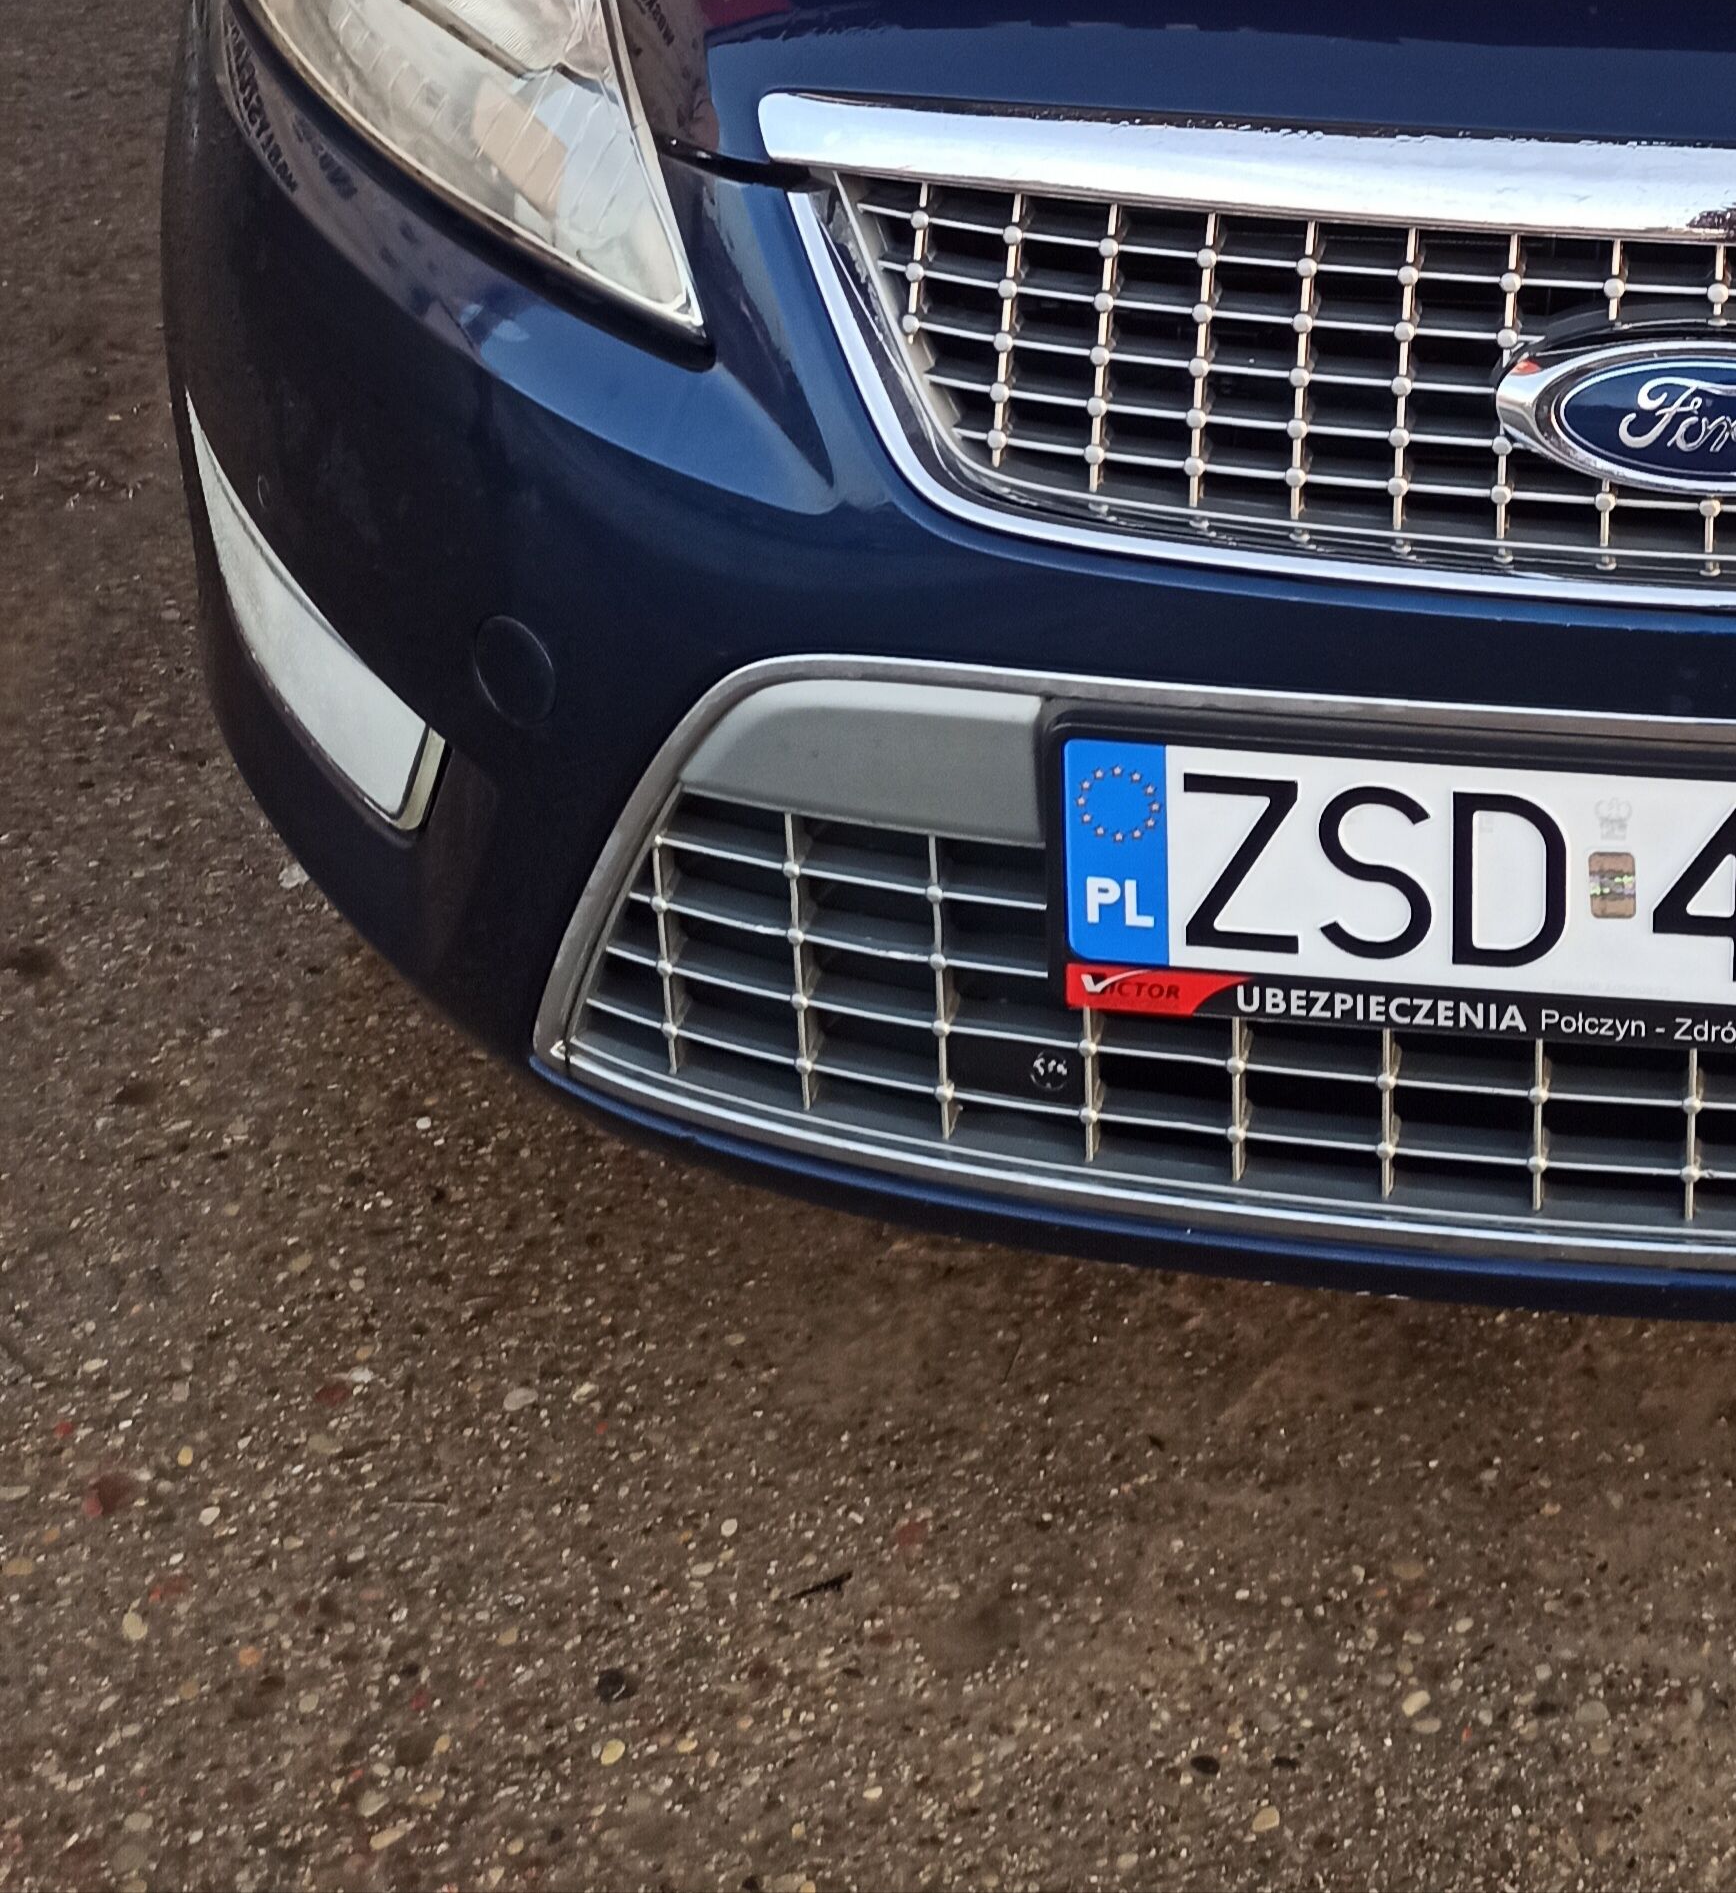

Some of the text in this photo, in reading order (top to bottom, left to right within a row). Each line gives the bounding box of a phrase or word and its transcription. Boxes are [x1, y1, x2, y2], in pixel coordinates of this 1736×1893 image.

[1183, 772, 1568, 967] ZSD
[1086, 876, 1155, 930] PL
[1236, 983, 1527, 1034] UBEZPIECZENIA
[1540, 1009, 1647, 1044] Połczyn
